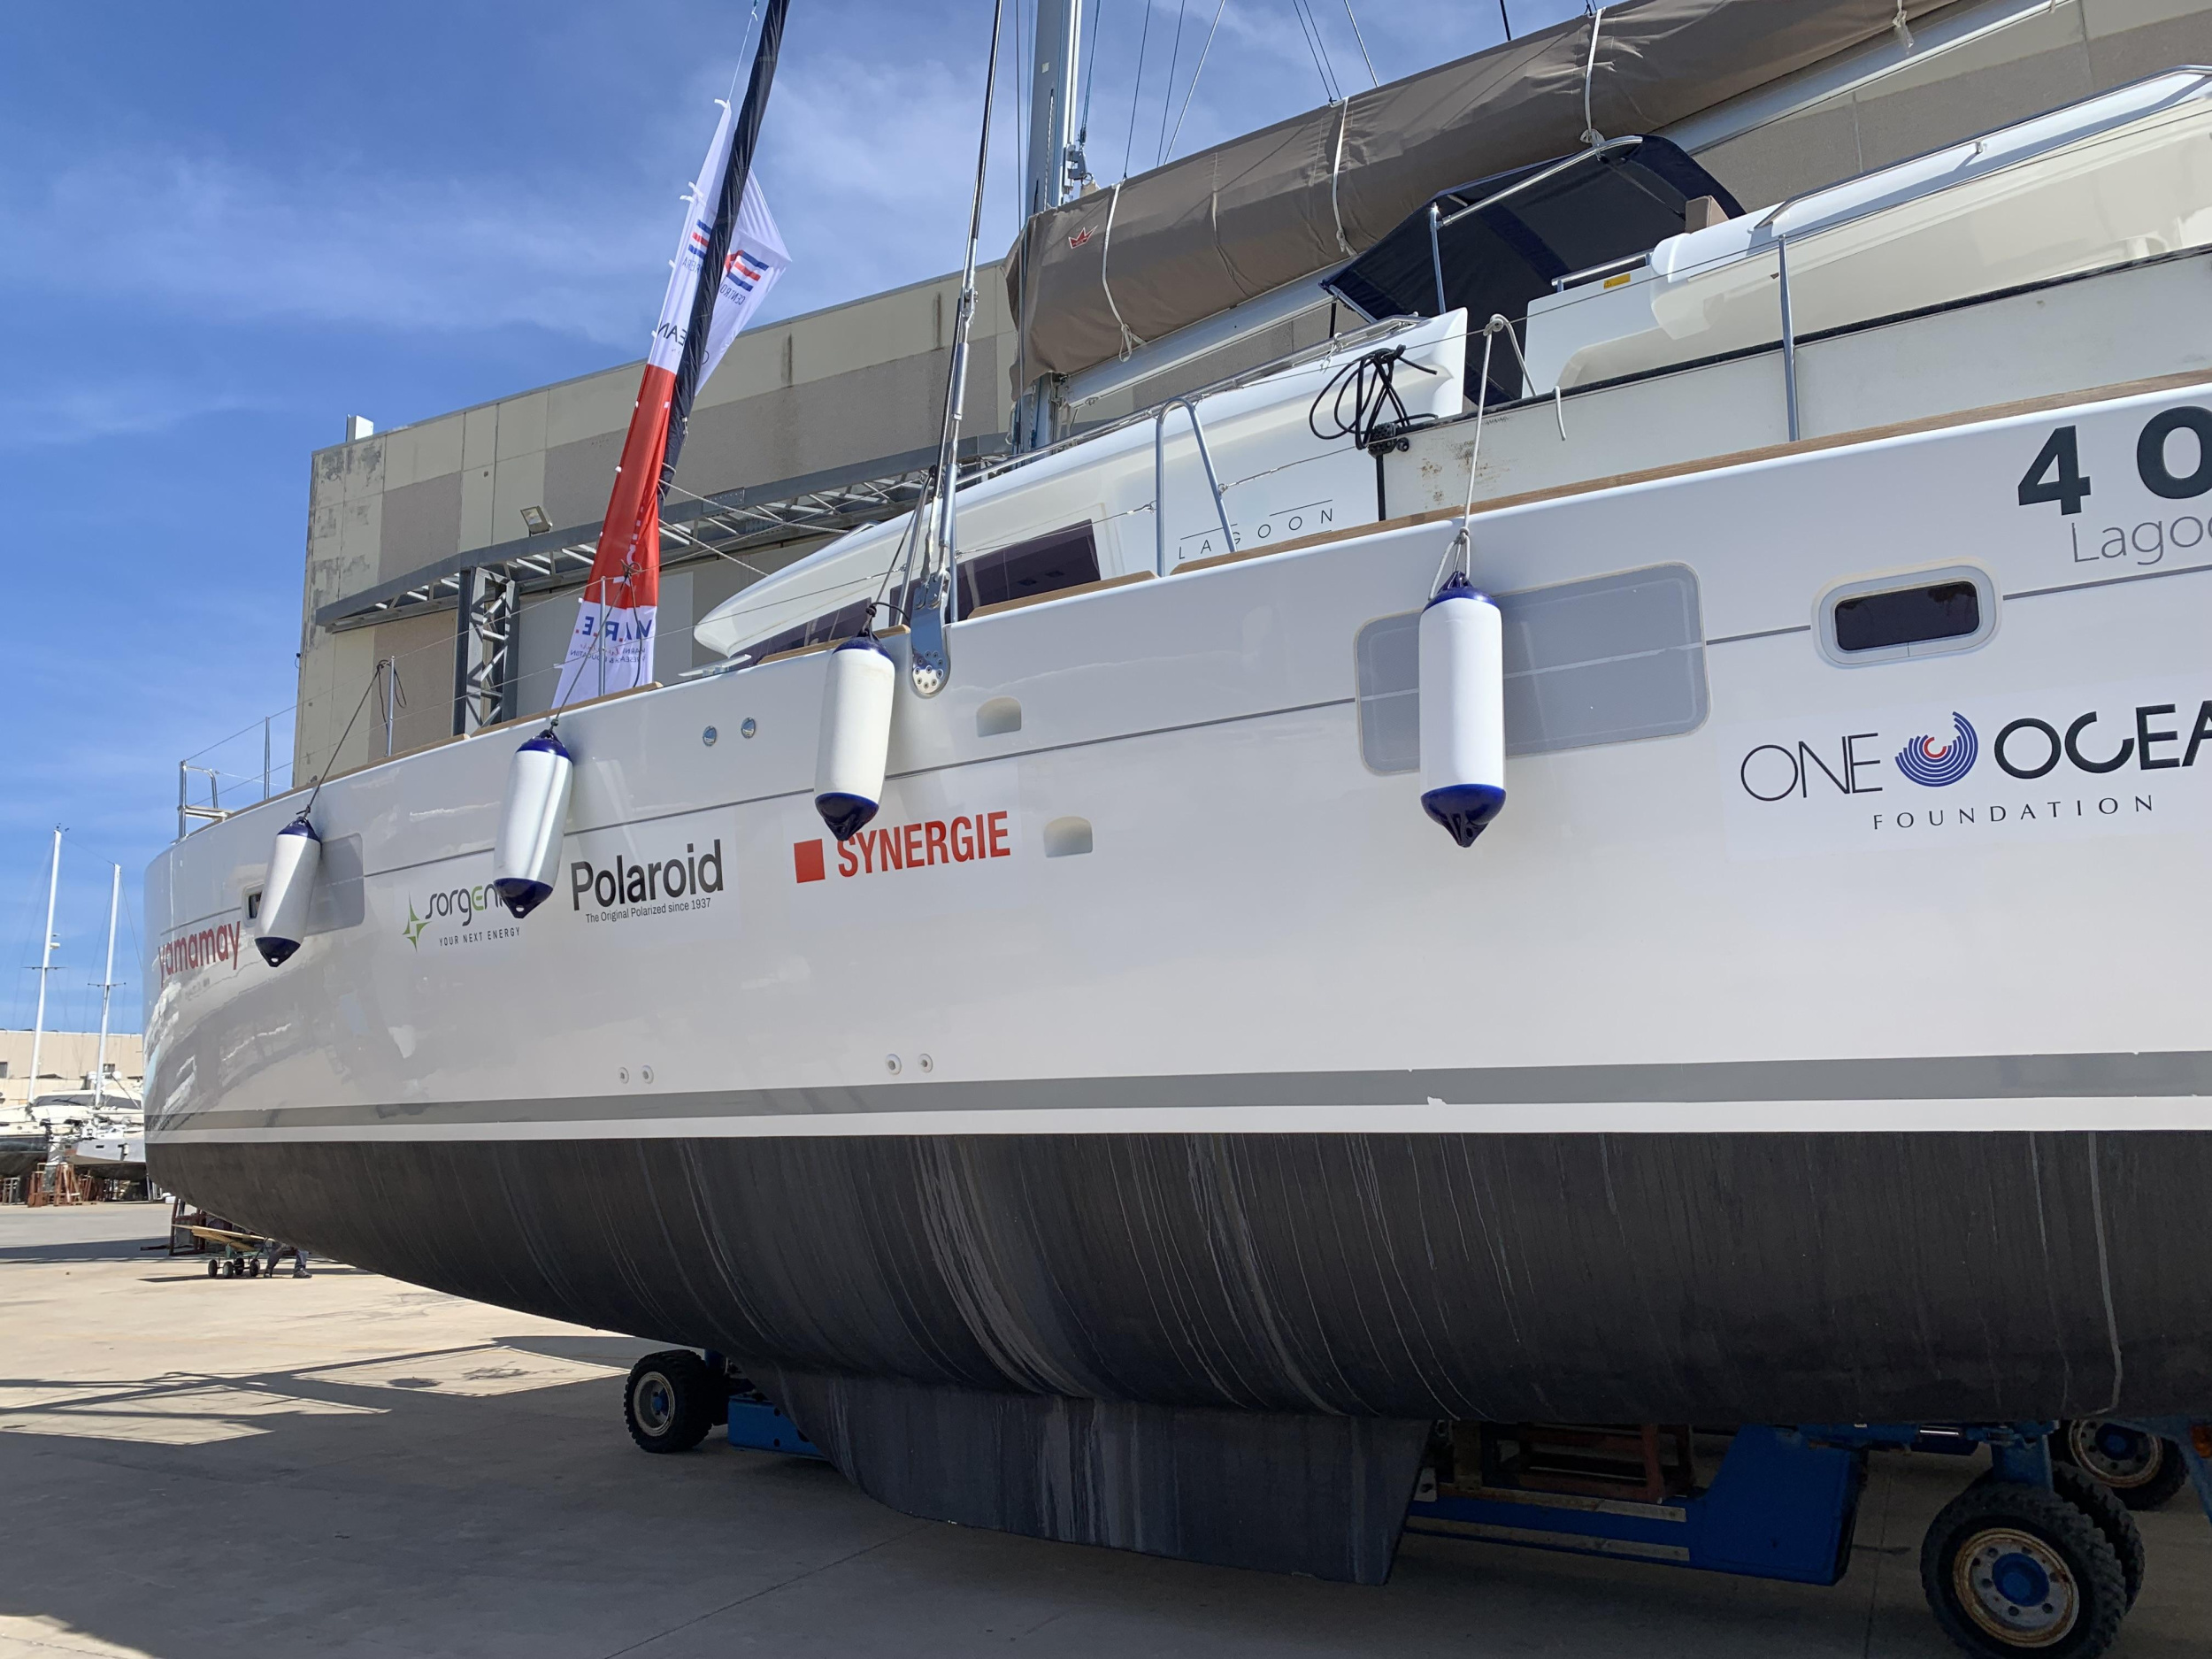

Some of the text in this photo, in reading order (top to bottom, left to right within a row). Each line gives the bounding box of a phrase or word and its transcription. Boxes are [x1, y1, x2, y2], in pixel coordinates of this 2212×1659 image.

[2071, 516, 2212, 565] Lago
[1740, 733, 1883, 801] ONE
[1873, 795, 2153, 830] FOUNDATION
[837, 810, 1010, 877] SYNERGIE
[571, 839, 724, 910] Polaroid
[426, 883, 504, 926] sorgen
[586, 898, 711, 923] The Original Polarized since 1937
[158, 921, 241, 988] yamamay
[439, 926, 520, 946] YOUR NEXT ENERGY
